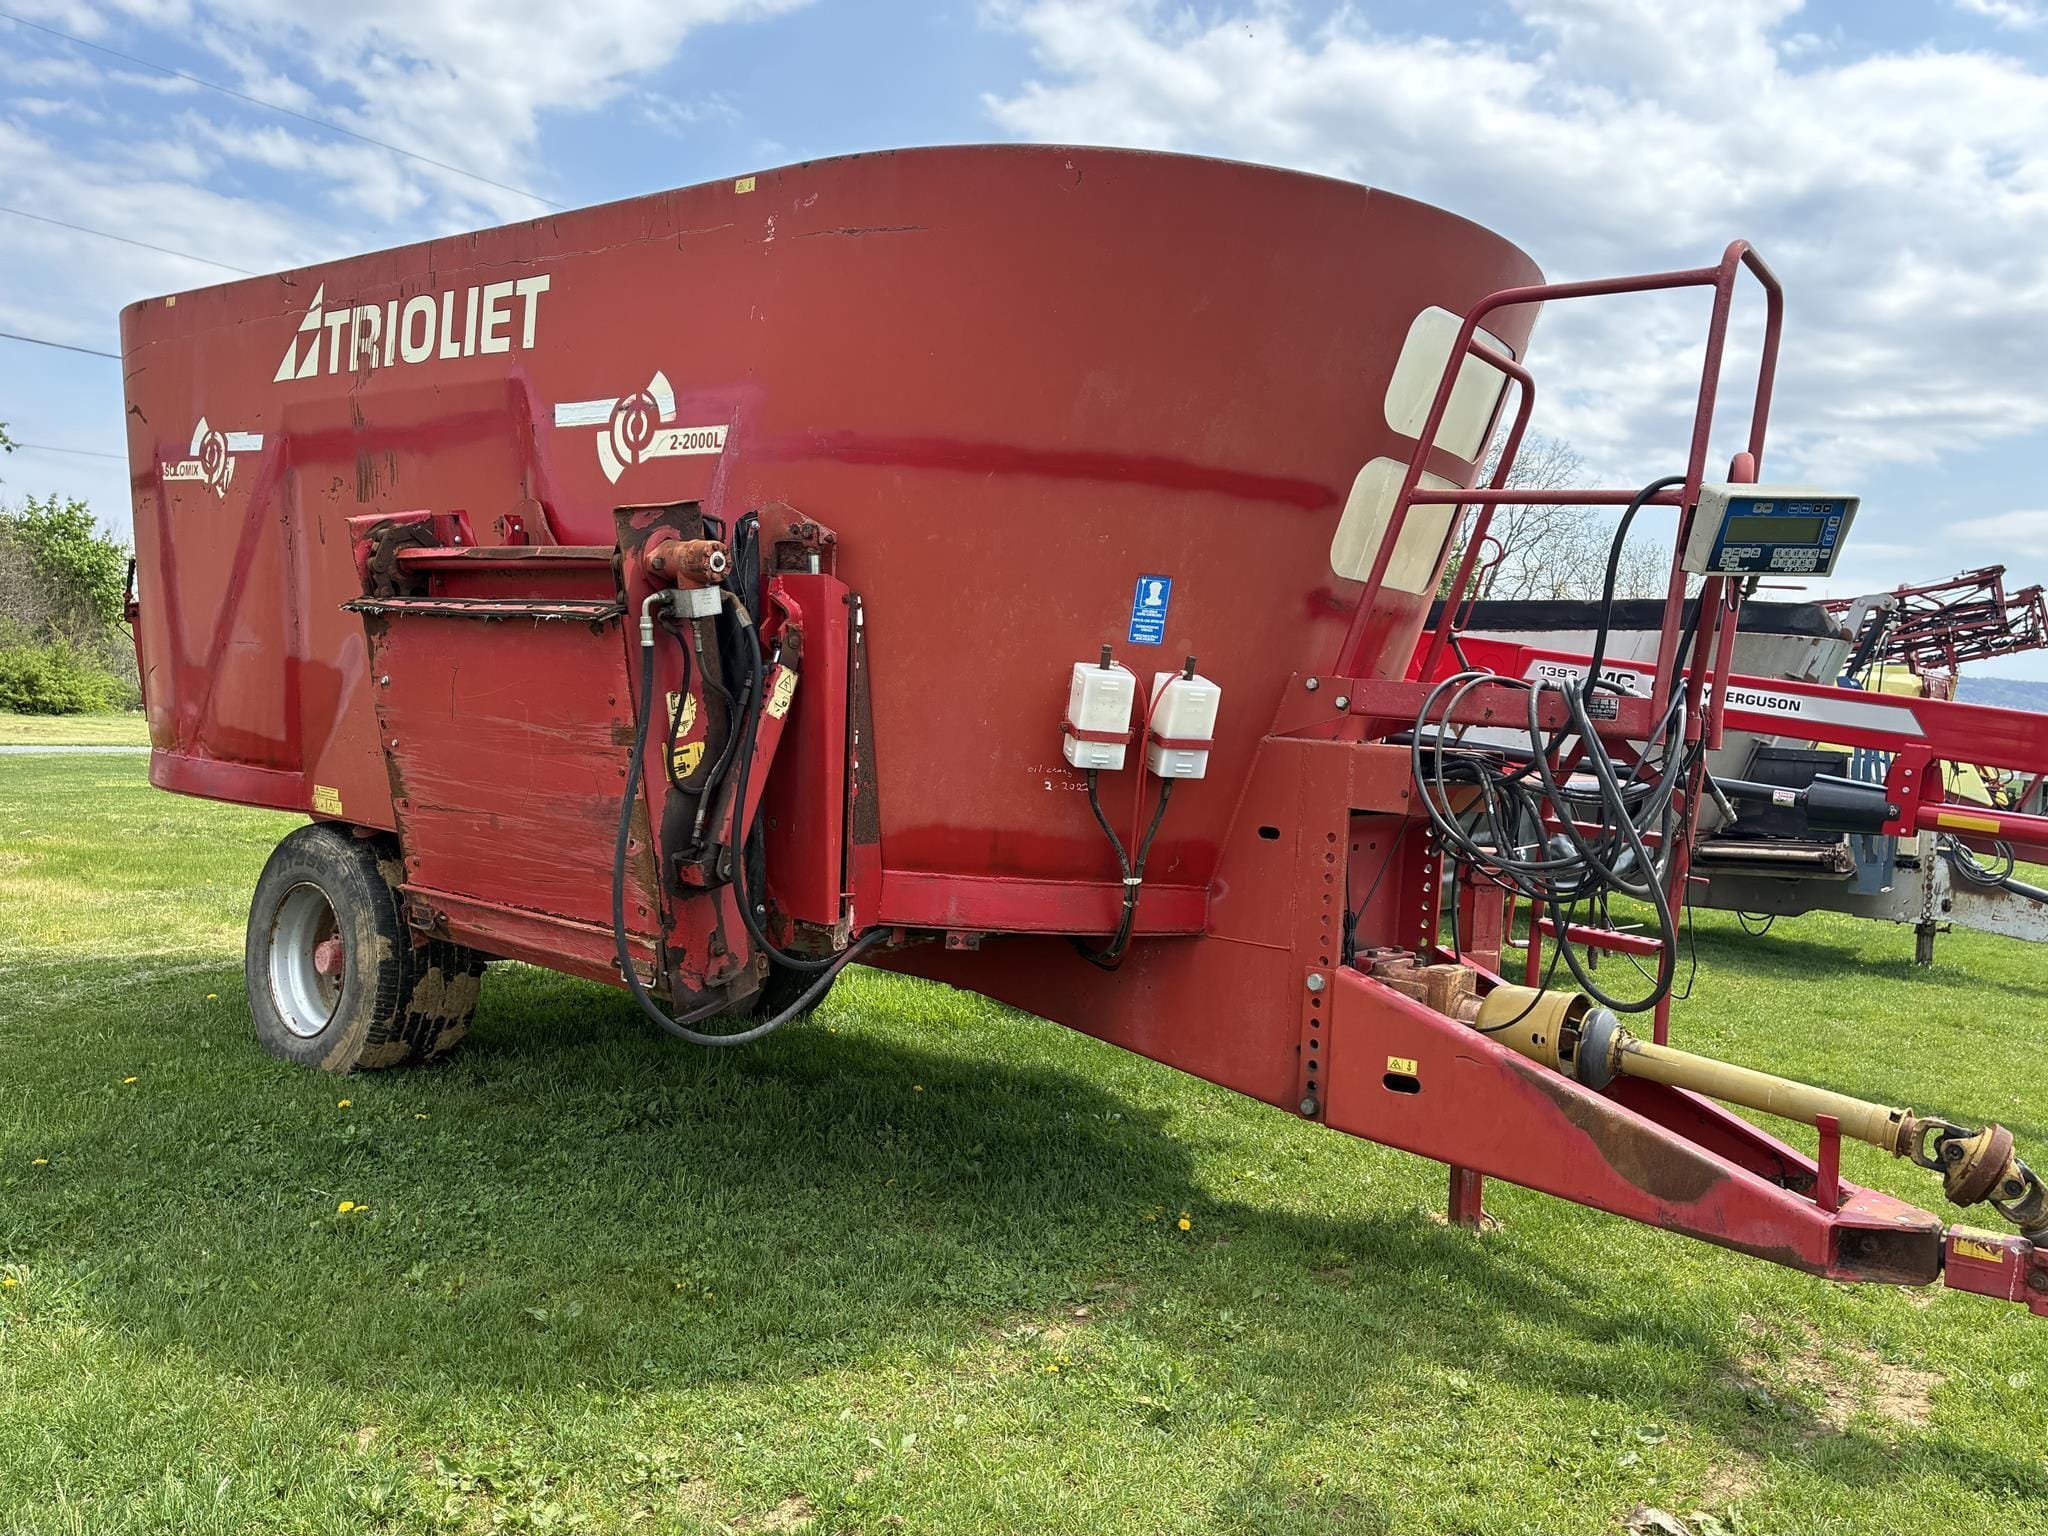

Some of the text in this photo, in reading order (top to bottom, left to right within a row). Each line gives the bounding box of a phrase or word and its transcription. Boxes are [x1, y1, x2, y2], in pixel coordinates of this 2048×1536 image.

[323, 273, 551, 375] TRIOLIET
[669, 431, 722, 450] 2-2000L
[1726, 691, 1801, 712] ERGUSON
